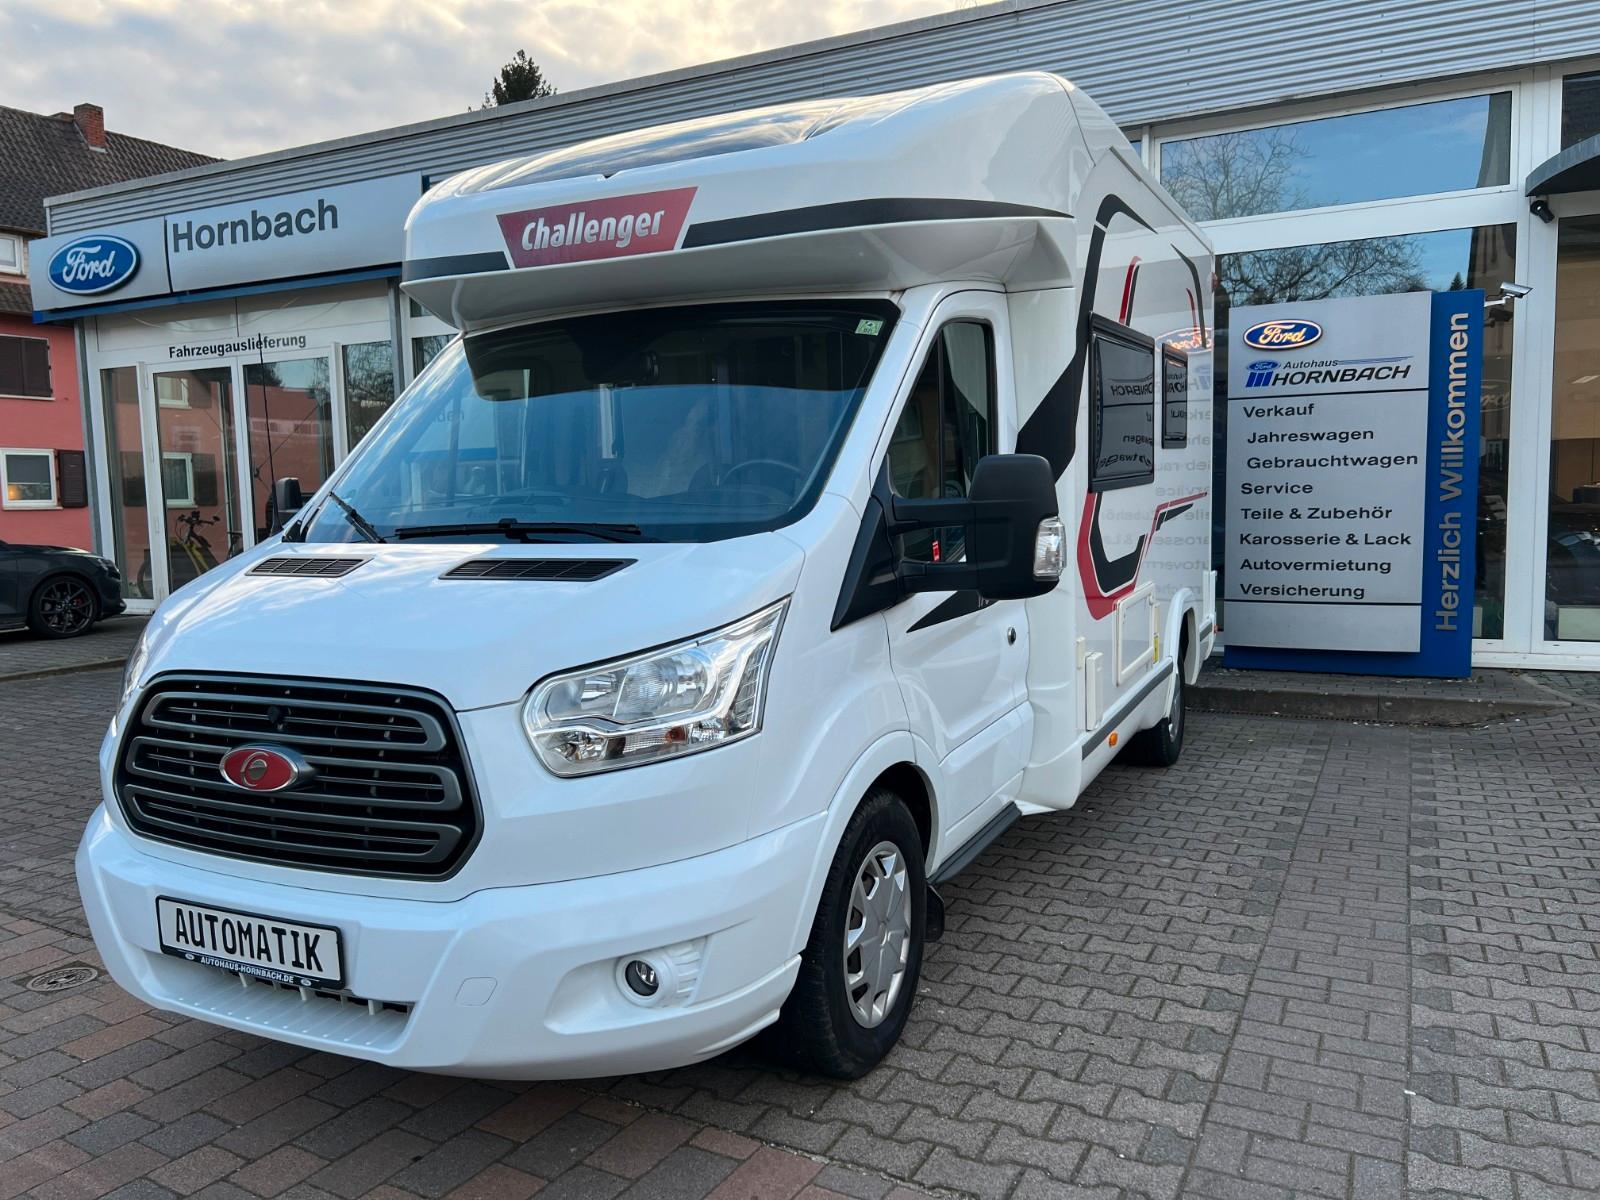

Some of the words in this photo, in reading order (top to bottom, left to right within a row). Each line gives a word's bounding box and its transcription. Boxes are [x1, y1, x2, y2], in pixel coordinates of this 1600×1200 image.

[172, 198, 338, 253] Hornbach
[521, 210, 665, 251] Challenger
[62, 245, 116, 283] Ford
[1258, 322, 1308, 346] Ford
[169, 333, 307, 359] Fahrzeugauslieferung
[1283, 358, 1339, 369] Autohaus
[1271, 365, 1411, 387] HORNBACH
[1243, 403, 1315, 418] Verkauf
[1439, 311, 1469, 502] Willkommen
[1247, 428, 1374, 445] Jahreswagen
[1246, 453, 1418, 470] Gebrauchtwagen
[1241, 481, 1314, 495] Service
[1241, 507, 1284, 520] Teile
[1289, 507, 1302, 519] &
[1307, 505, 1392, 520] Zubehör
[1239, 532, 1341, 546] Karosserie
[1345, 533, 1359, 545] &
[1364, 532, 1412, 545] Lack
[1240, 558, 1392, 574] Autovermietung
[1435, 512, 1462, 632] Herzlich
[1240, 583, 1365, 600] Versicherung
[176, 907, 324, 973] AUTOMATIK
[201, 956, 294, 984] AUTOHAUS-HORNBACH.DE
